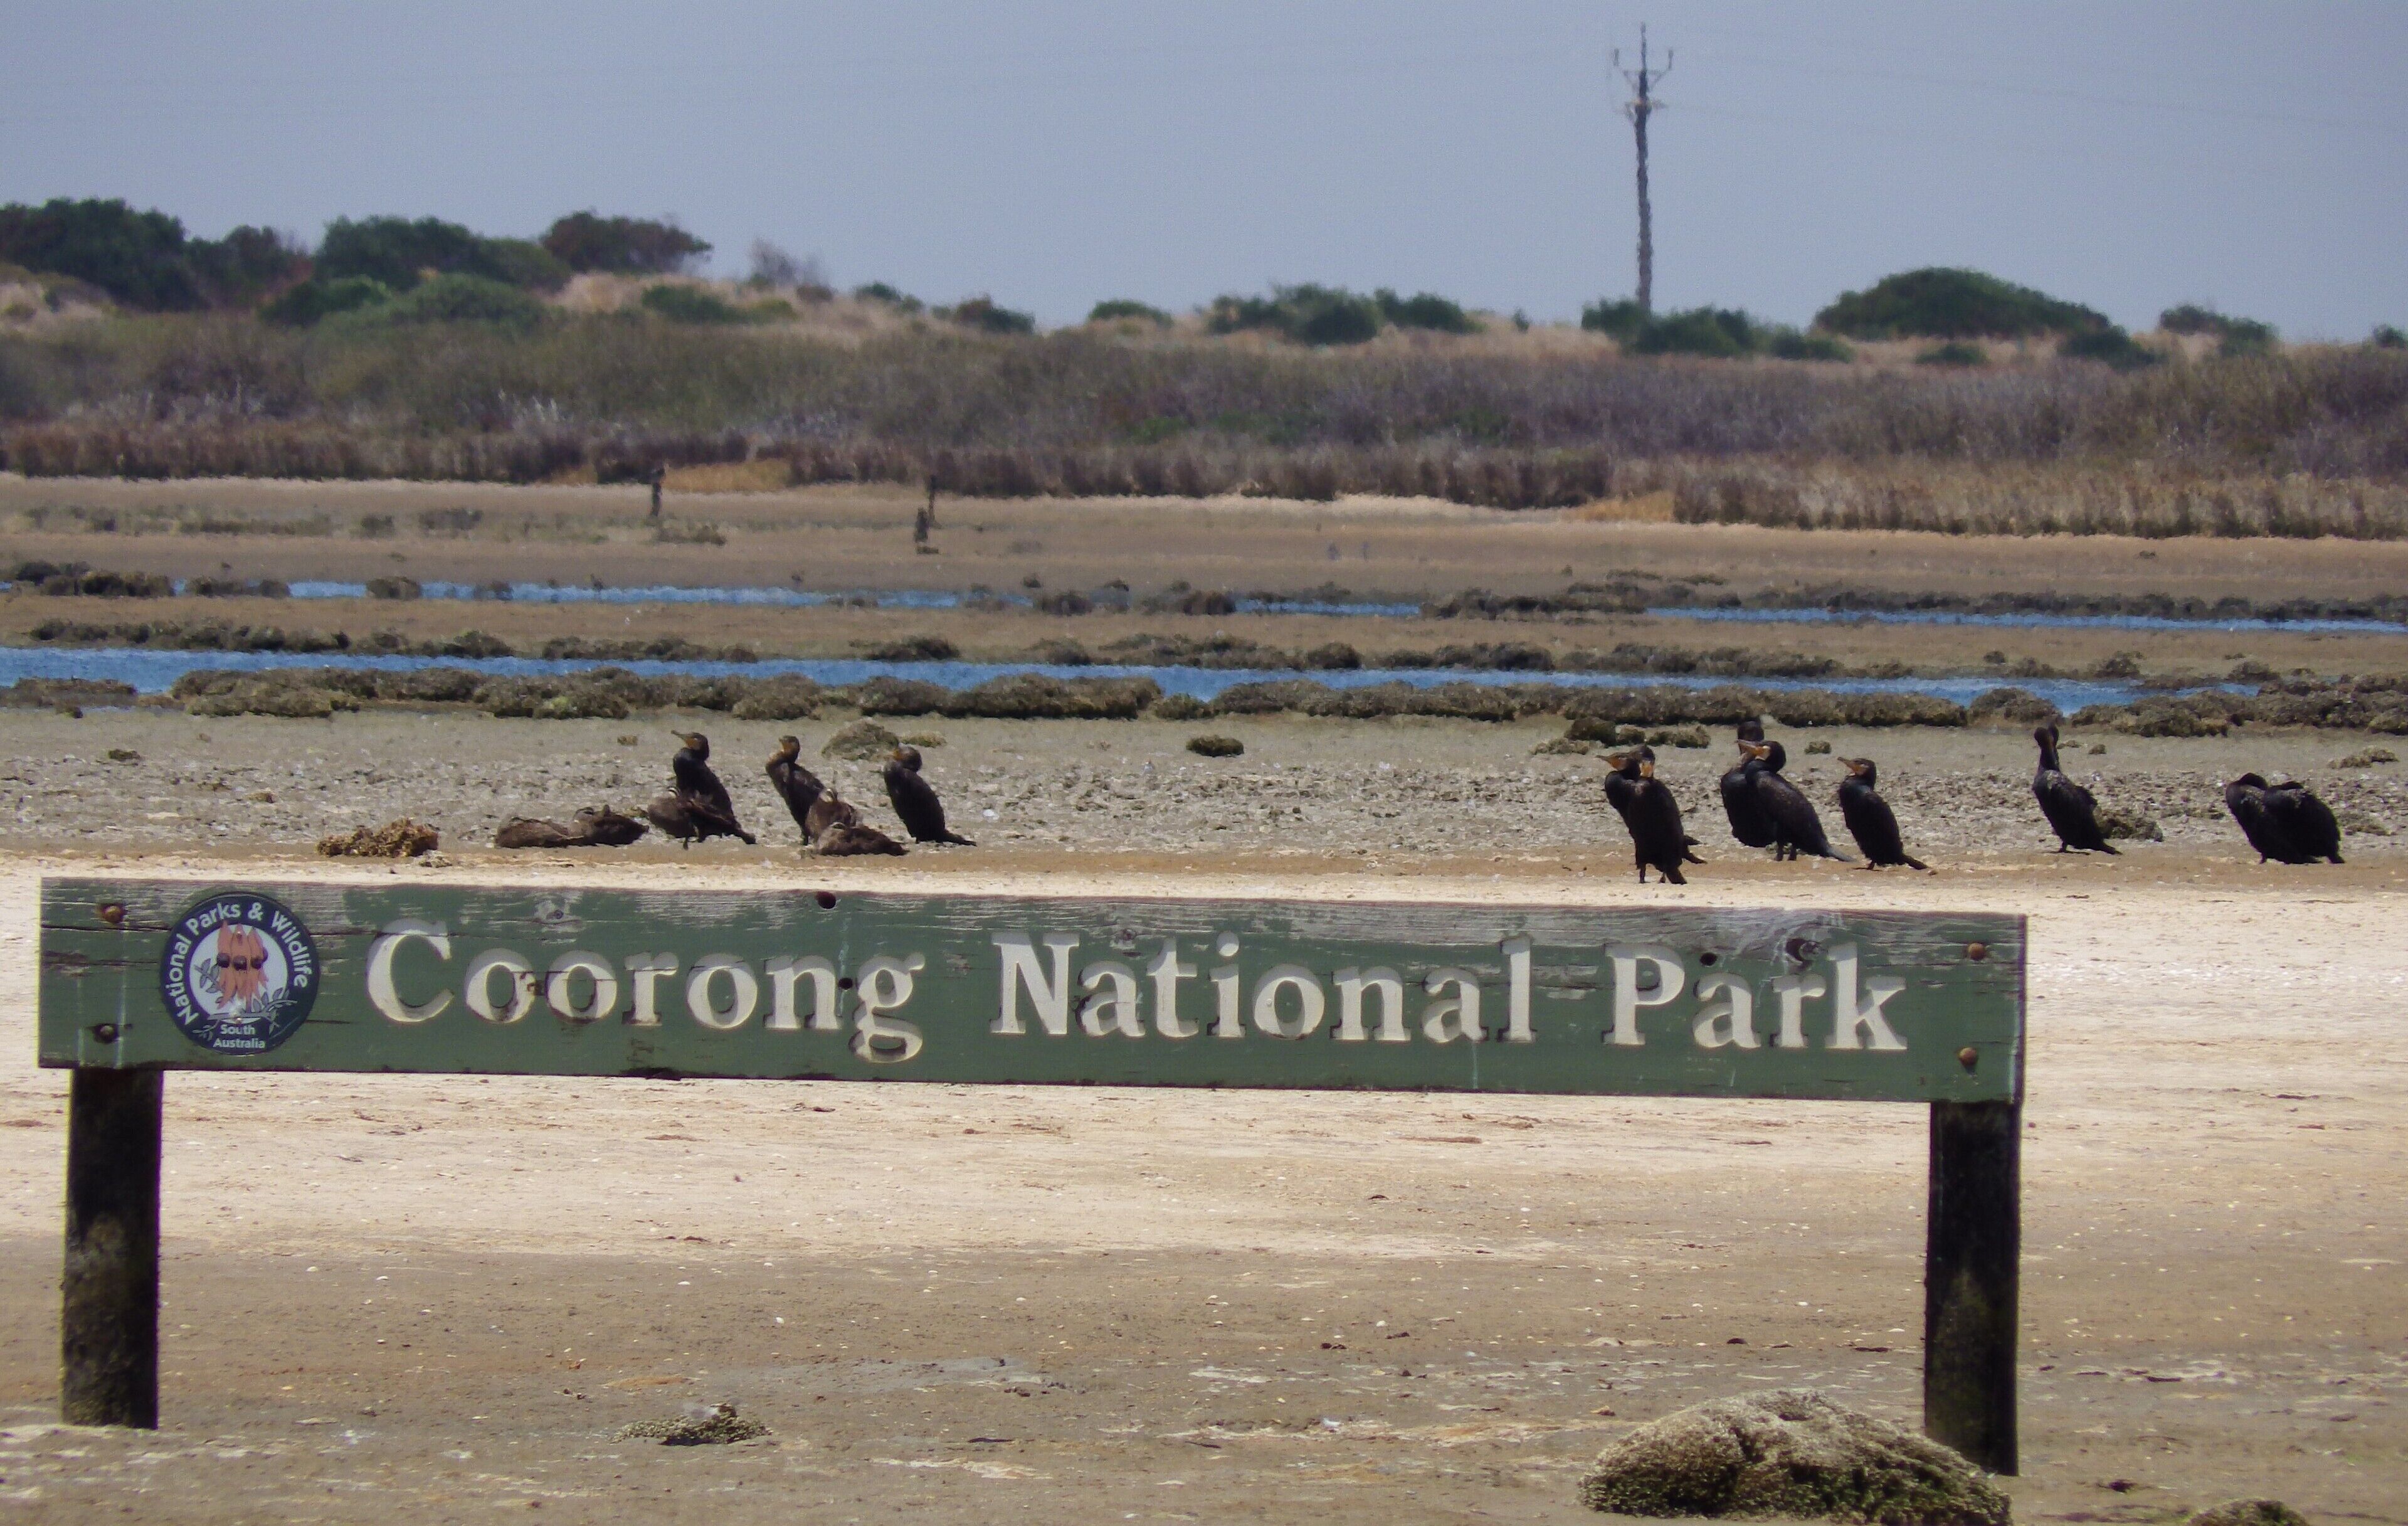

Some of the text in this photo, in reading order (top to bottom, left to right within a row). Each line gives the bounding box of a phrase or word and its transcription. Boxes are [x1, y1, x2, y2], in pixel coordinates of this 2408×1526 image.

[166, 903, 312, 1025] National Parks & Wildlife
[366, 917, 1908, 1063] Coorong National Park
[213, 1039, 265, 1049] Australia
[220, 1024, 255, 1035] South
